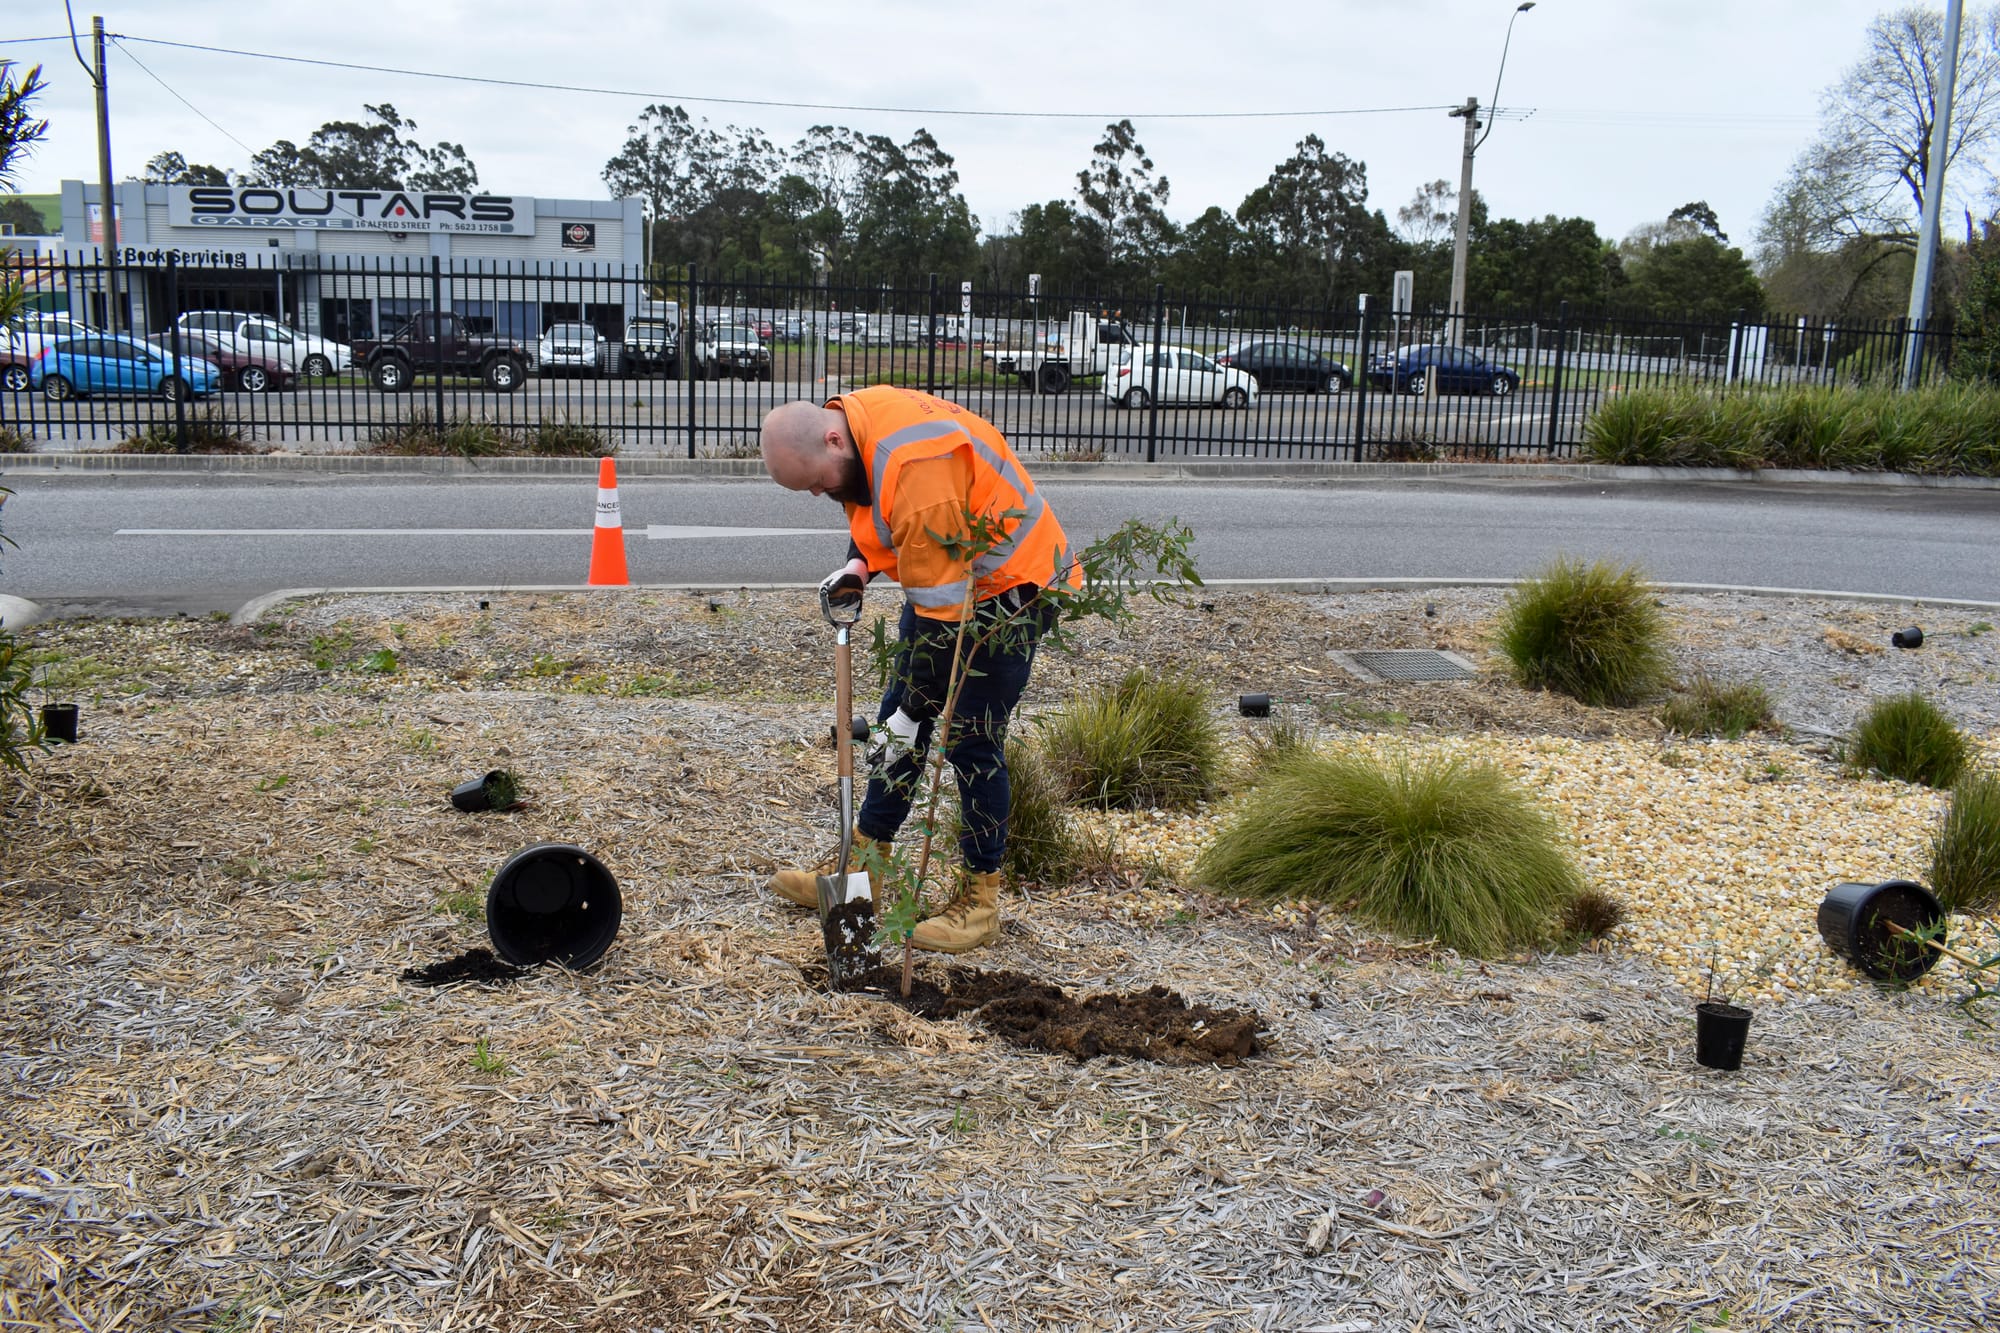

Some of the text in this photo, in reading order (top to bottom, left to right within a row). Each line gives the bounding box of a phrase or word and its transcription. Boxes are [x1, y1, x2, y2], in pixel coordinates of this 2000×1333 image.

[189, 188, 514, 222] SOUTARS
[197, 216, 344, 228] GARAGE
[356, 220, 499, 232] 16 ALFRED STREET Ph: 5623 1758
[125, 247, 166, 263] Book
